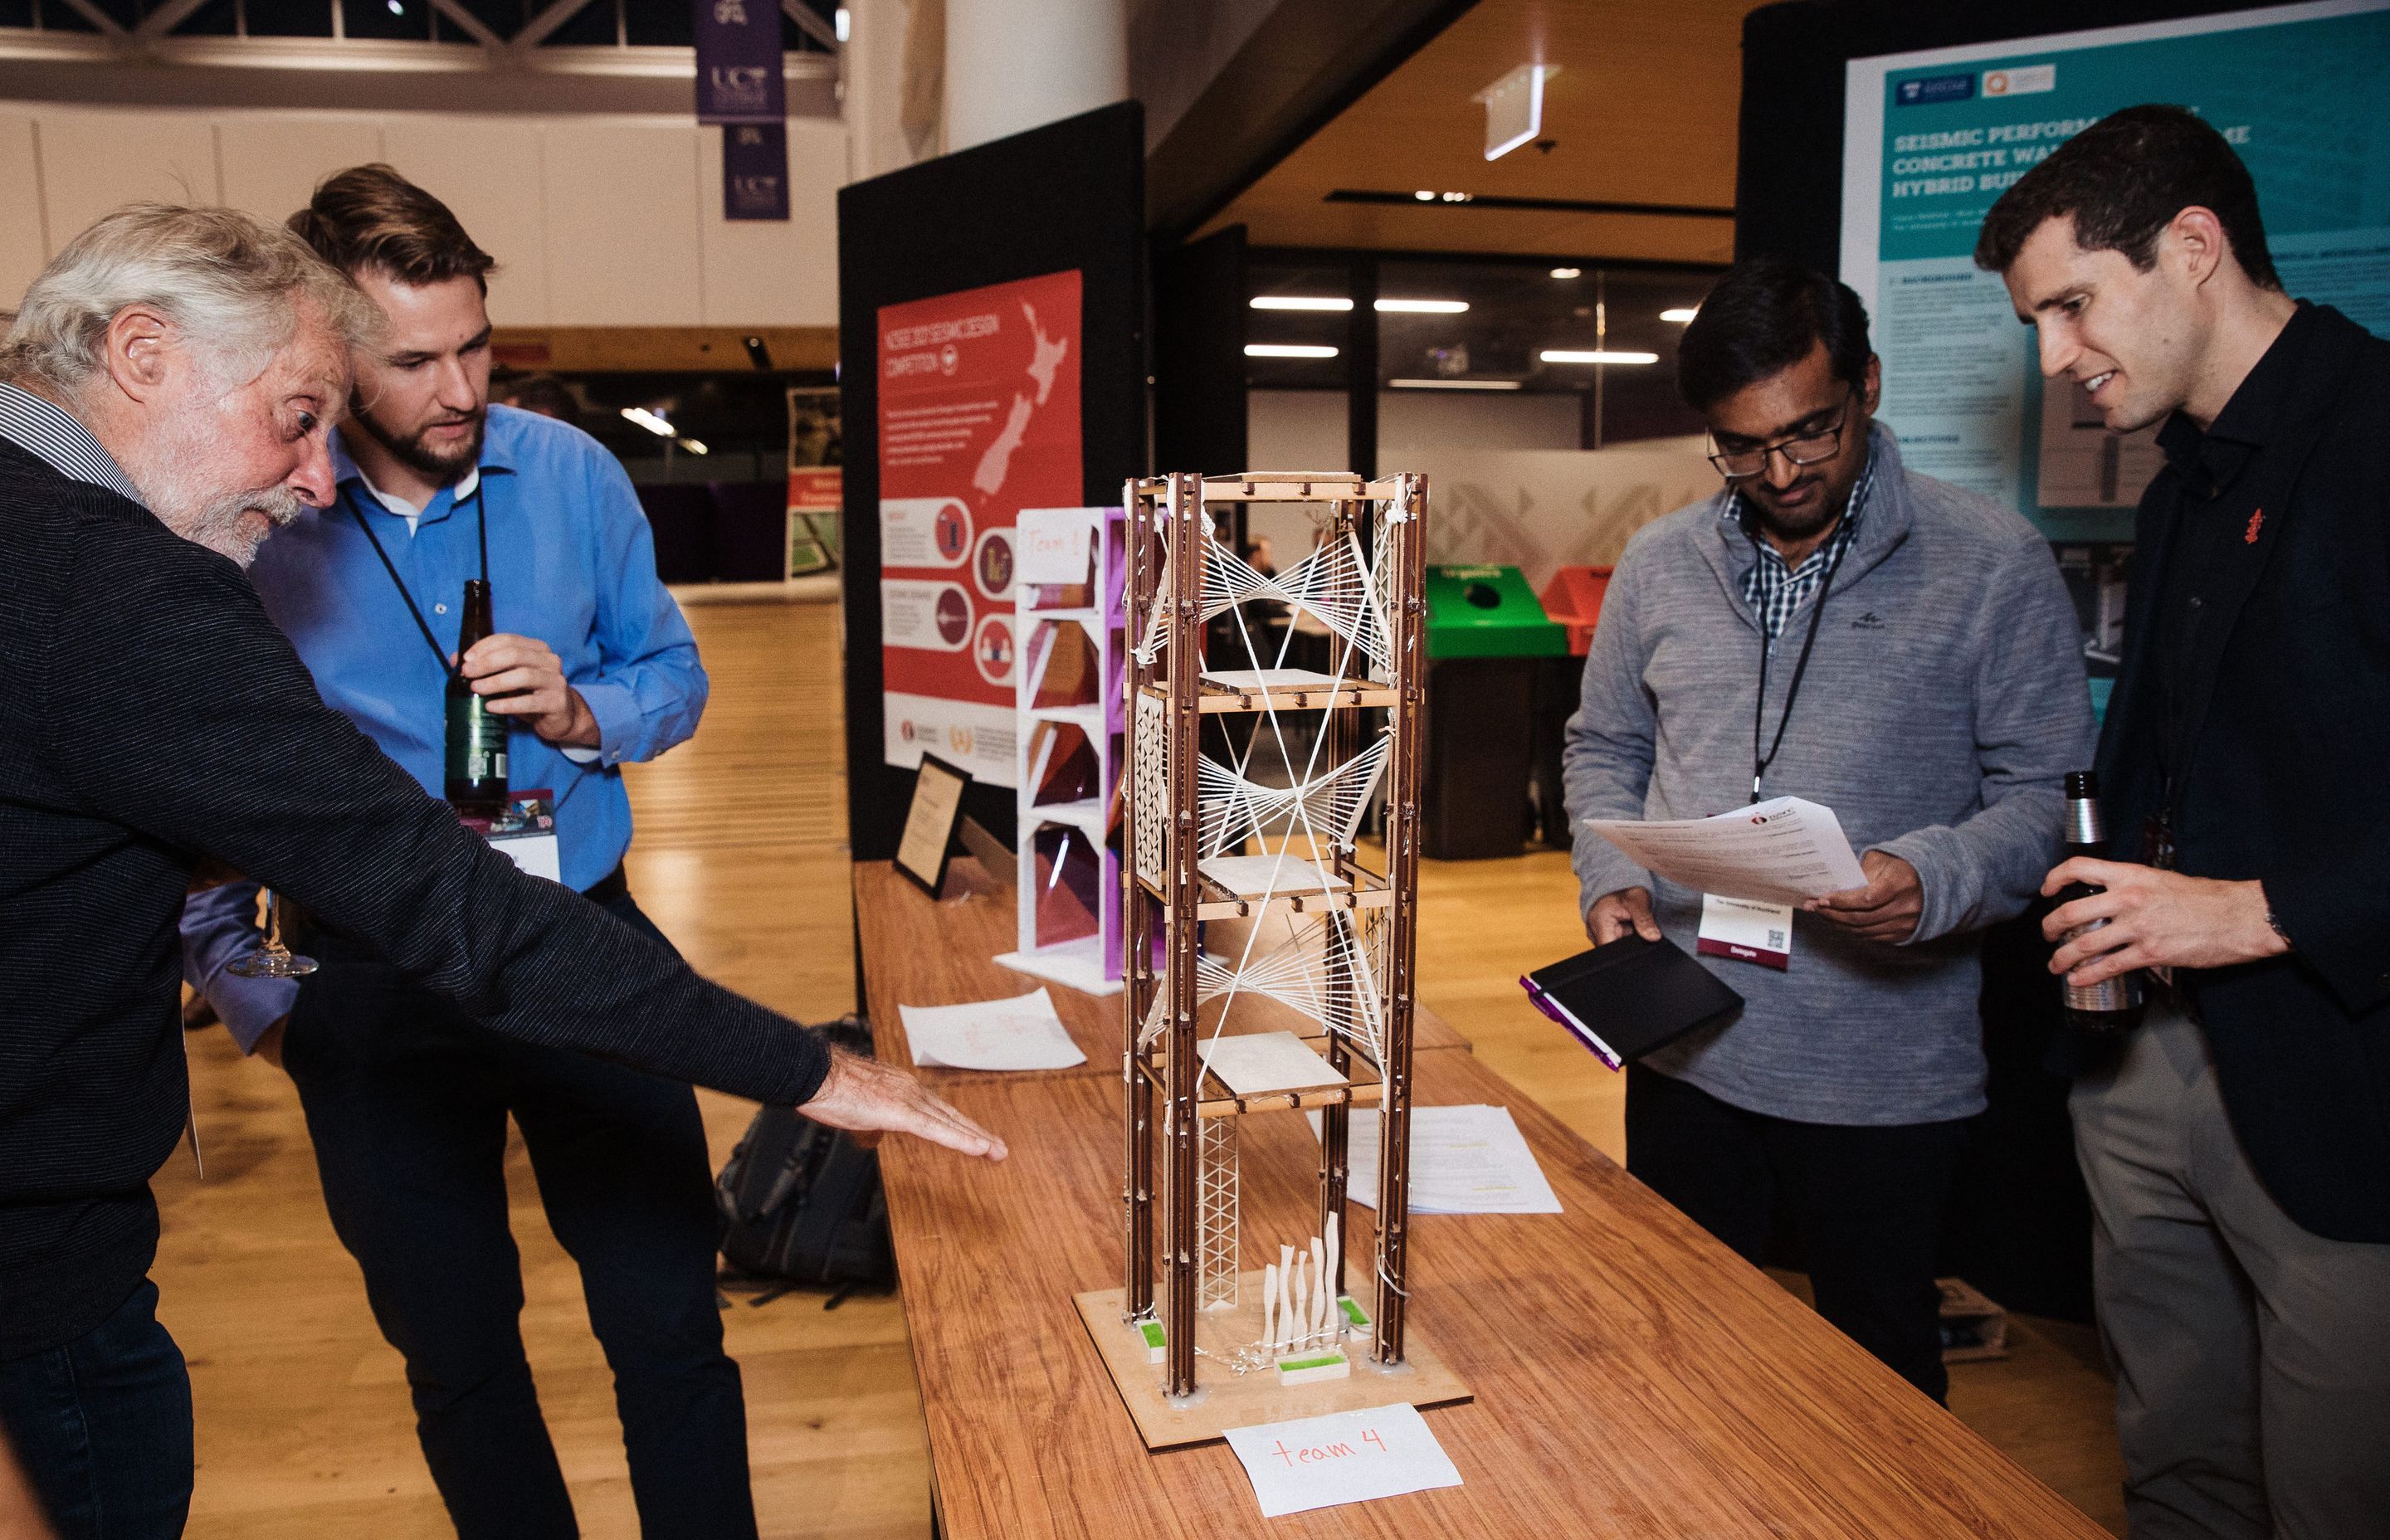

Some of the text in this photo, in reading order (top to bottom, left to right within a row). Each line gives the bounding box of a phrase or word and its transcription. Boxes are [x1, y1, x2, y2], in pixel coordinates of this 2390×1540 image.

[1895, 117, 2098, 153] SEISMIC PERFORM
[1893, 149, 2007, 175] CONCRETE
[1892, 175, 1975, 198] HYBRID
[1272, 1429, 1387, 1467] team 4
